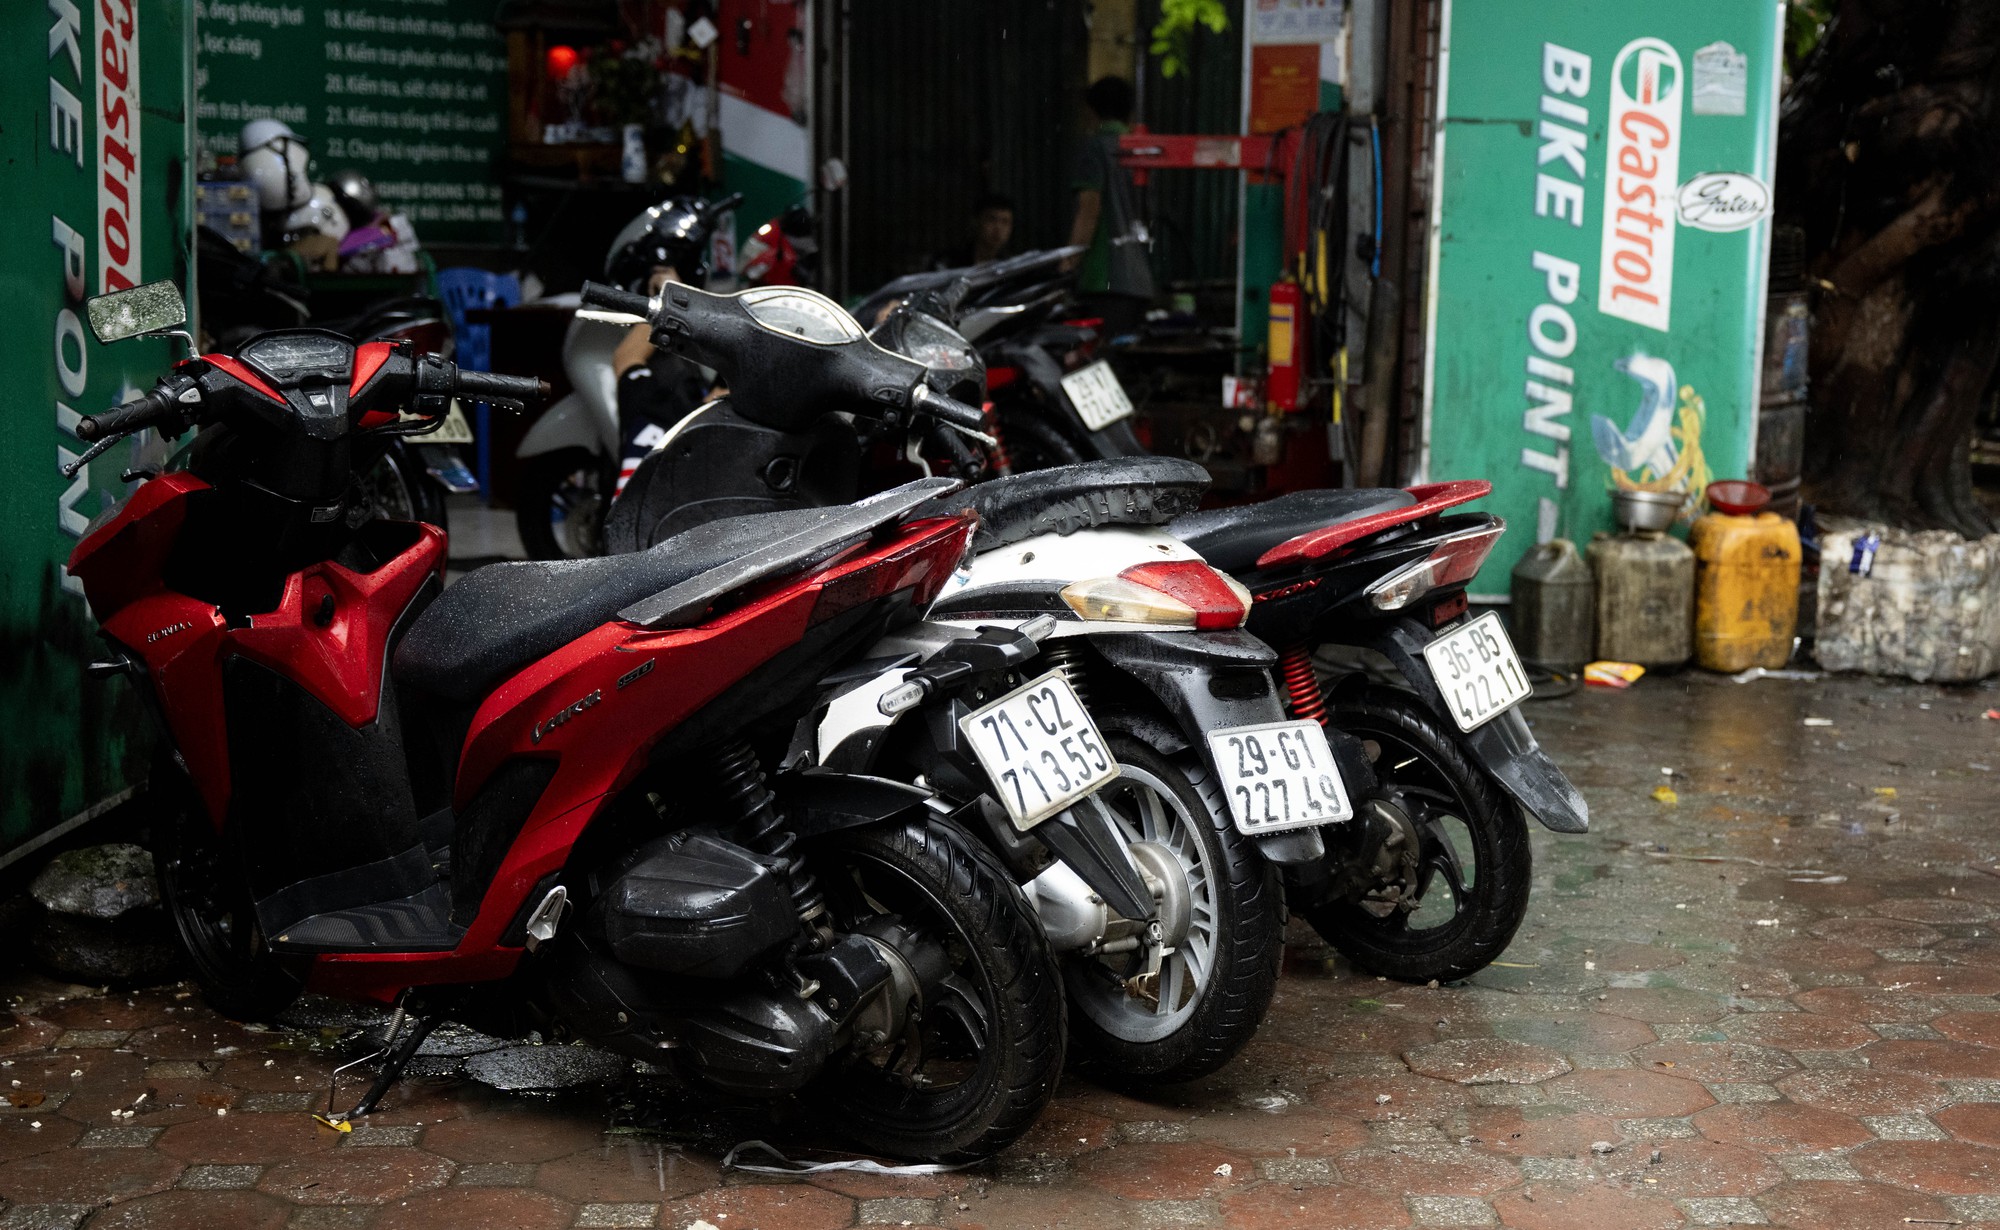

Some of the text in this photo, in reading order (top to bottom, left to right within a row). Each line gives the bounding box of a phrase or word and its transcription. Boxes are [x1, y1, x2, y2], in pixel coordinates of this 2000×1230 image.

[1611, 110, 1670, 306] Castrol
[1521, 41, 1592, 489] BIKE POINT
[1434, 620, 1461, 637] HONDA
[1453, 658, 1525, 722] 422.11
[1001, 728, 1108, 817] 713.55
[1235, 774, 1342, 826] 227.49
